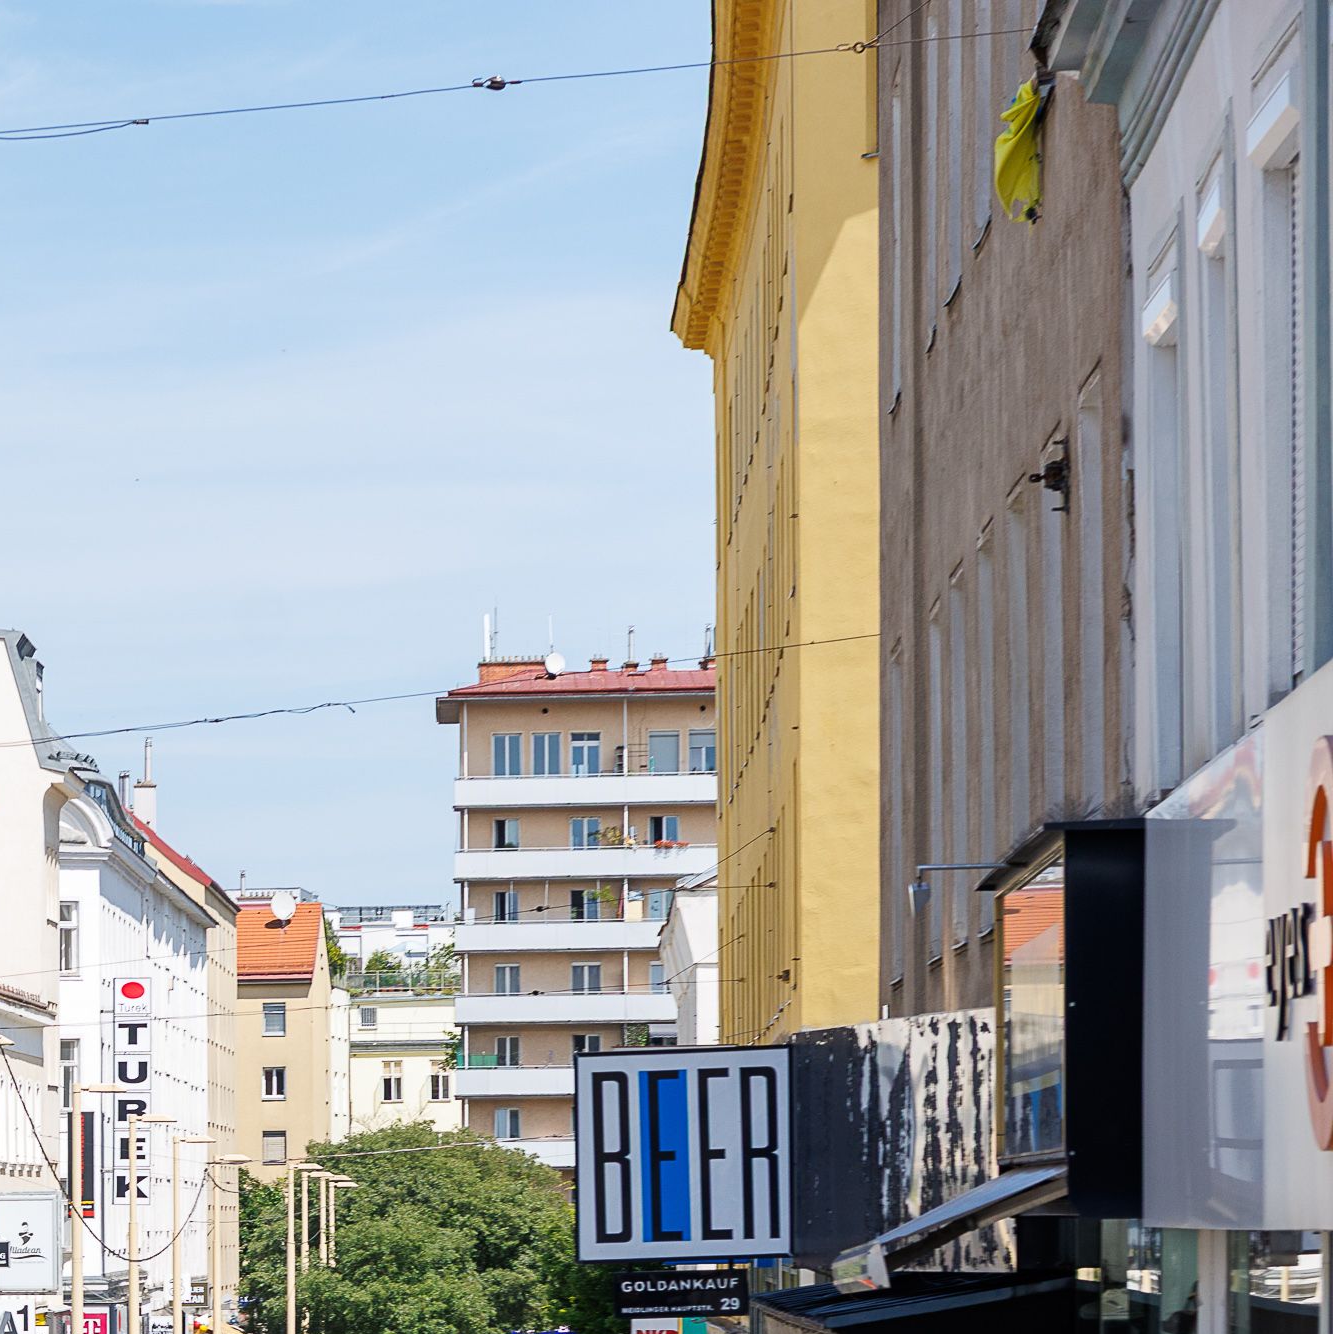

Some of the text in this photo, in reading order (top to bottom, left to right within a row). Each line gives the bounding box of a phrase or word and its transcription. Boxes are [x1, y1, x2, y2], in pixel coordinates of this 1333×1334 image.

[118, 1003, 149, 1013] Turek
[116, 1023, 149, 1199] TUREK
[592, 1066, 781, 1244] BEER
[621, 1278, 739, 1292] GOLDANKAUF
[720, 1297, 740, 1311] 29
